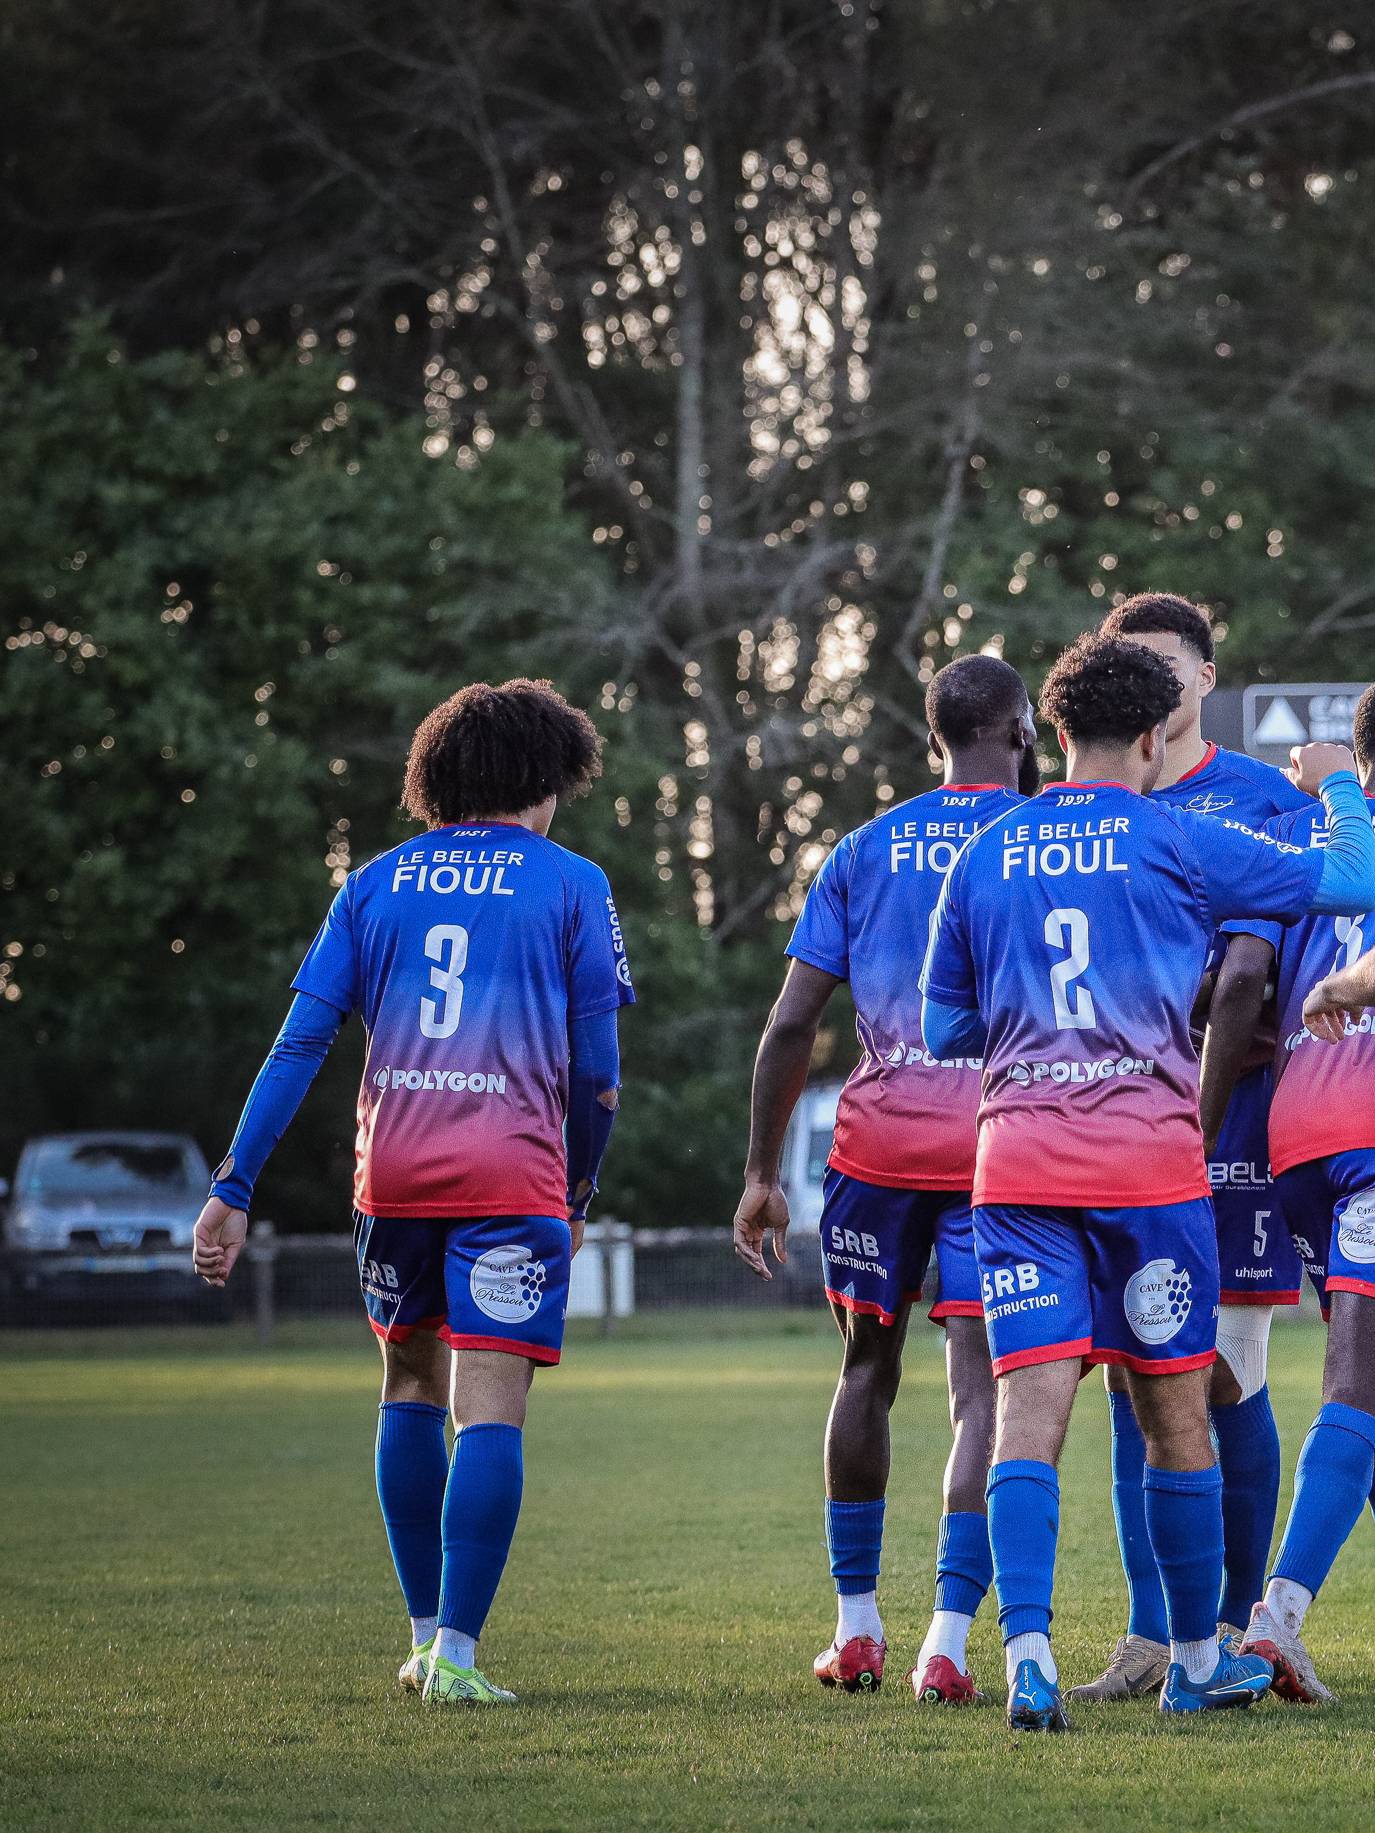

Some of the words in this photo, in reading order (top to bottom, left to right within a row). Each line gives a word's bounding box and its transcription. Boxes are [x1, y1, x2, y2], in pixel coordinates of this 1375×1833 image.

[891, 822, 917, 839] LE
[1003, 825, 1029, 845] LE
[1039, 817, 1130, 840] BELLER
[398, 851, 425, 865] LE
[432, 850, 524, 866] BELLER
[890, 841, 959, 874] FIO
[1003, 838, 1128, 881] FIOUL
[391, 865, 515, 895] FIOUL
[419, 924, 469, 1038] 3
[1044, 907, 1096, 1030] 2
[391, 1069, 507, 1095] POLYGON
[1033, 1057, 1154, 1083] POLYGON
[832, 1225, 880, 1257] SRB
[1253, 1211, 1271, 1257] 5
[489, 1263, 514, 1274] CAVE
[827, 1252, 888, 1280] CONSTRUCTION
[1235, 1267, 1273, 1280] uhlsport
[983, 1262, 1039, 1304] SRB
[1140, 1283, 1163, 1294] CAVE
